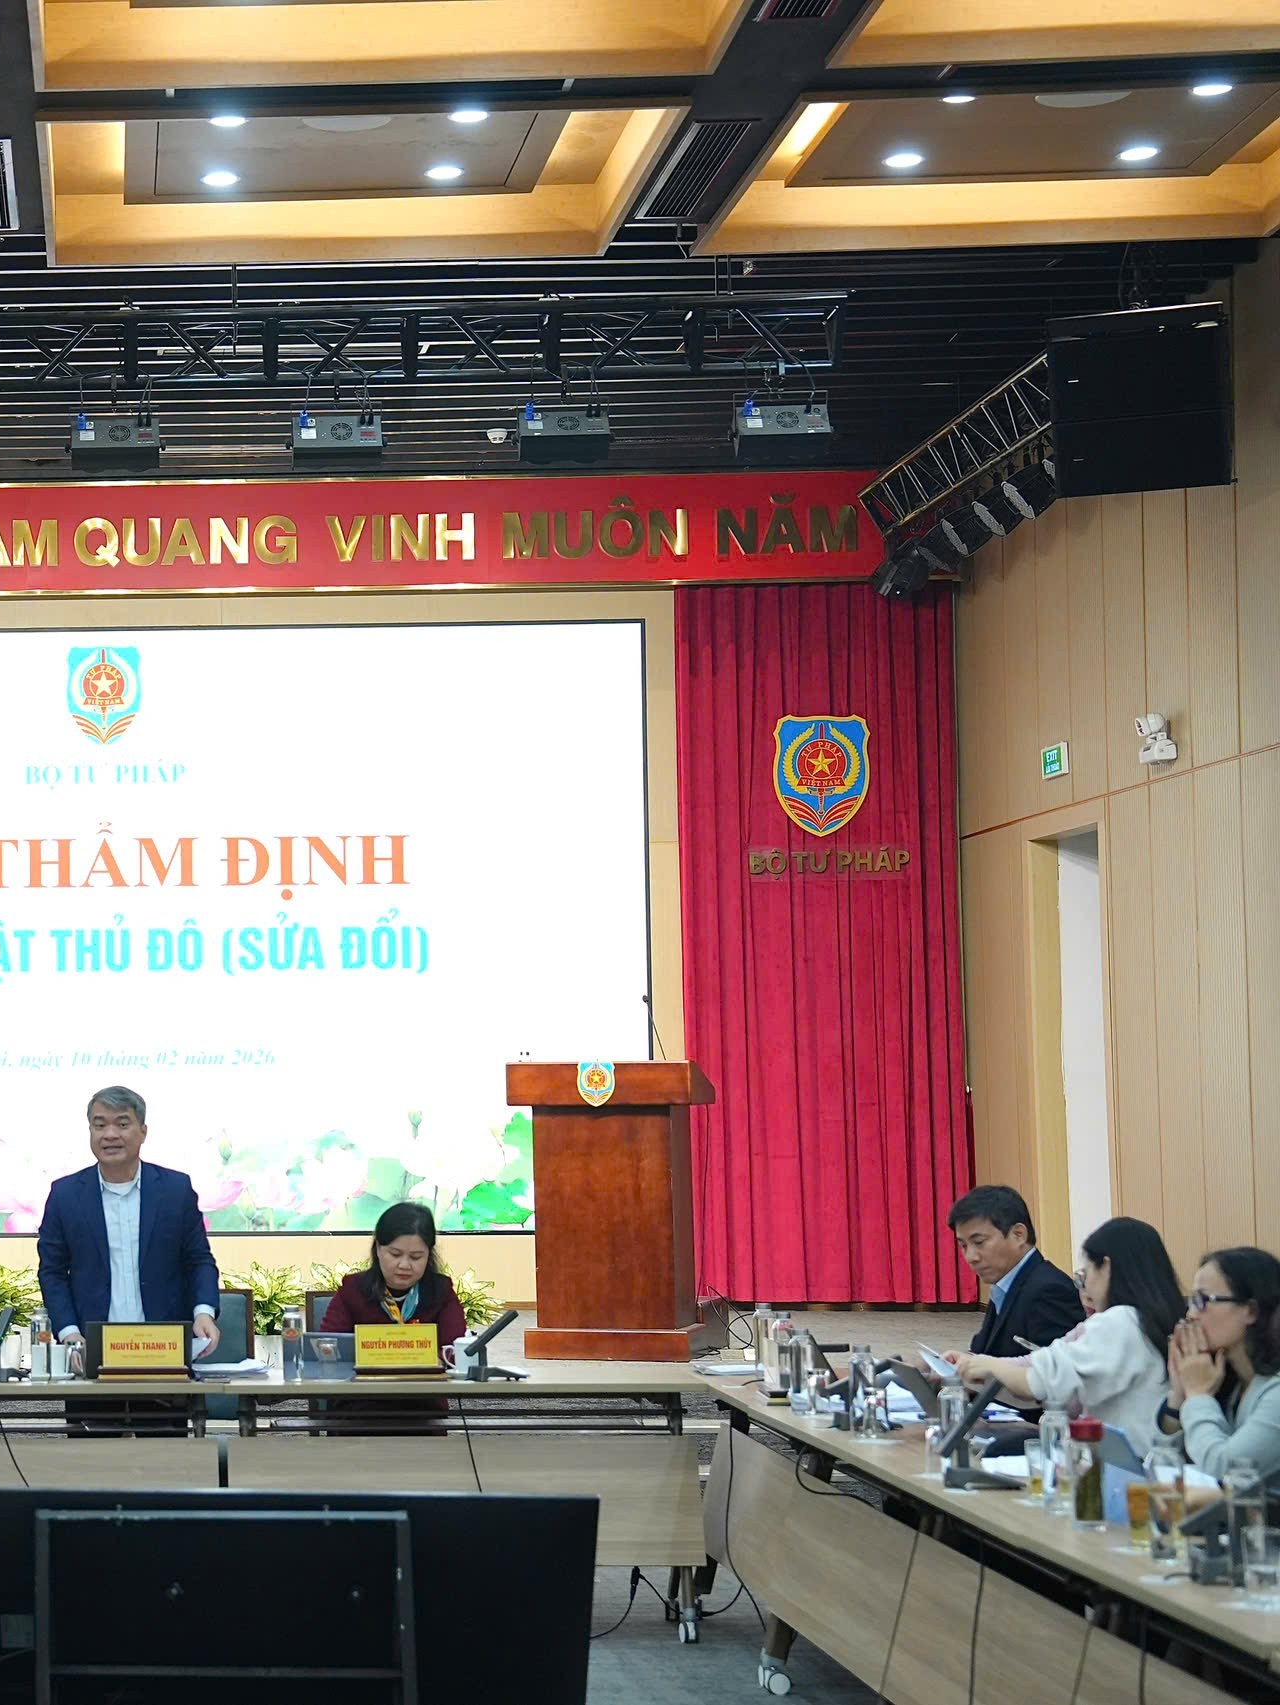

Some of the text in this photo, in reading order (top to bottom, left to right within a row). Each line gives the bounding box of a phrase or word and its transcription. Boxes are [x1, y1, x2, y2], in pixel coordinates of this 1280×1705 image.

[74, 515, 298, 567] QUANG
[325, 512, 475, 562] VINH
[502, 495, 689, 560] MUÔN
[716, 493, 859, 556] NĂM
[220, 834, 411, 901] ĐỊNH
[749, 845, 910, 880] BỘ TƯ PHÁP
[49, 913, 131, 973] THỦ
[145, 919, 204, 972] ĐÔ
[221, 911, 325, 976] (SỬA
[339, 908, 429, 975] ĐỔI)
[142, 1342, 166, 1350] THANH
